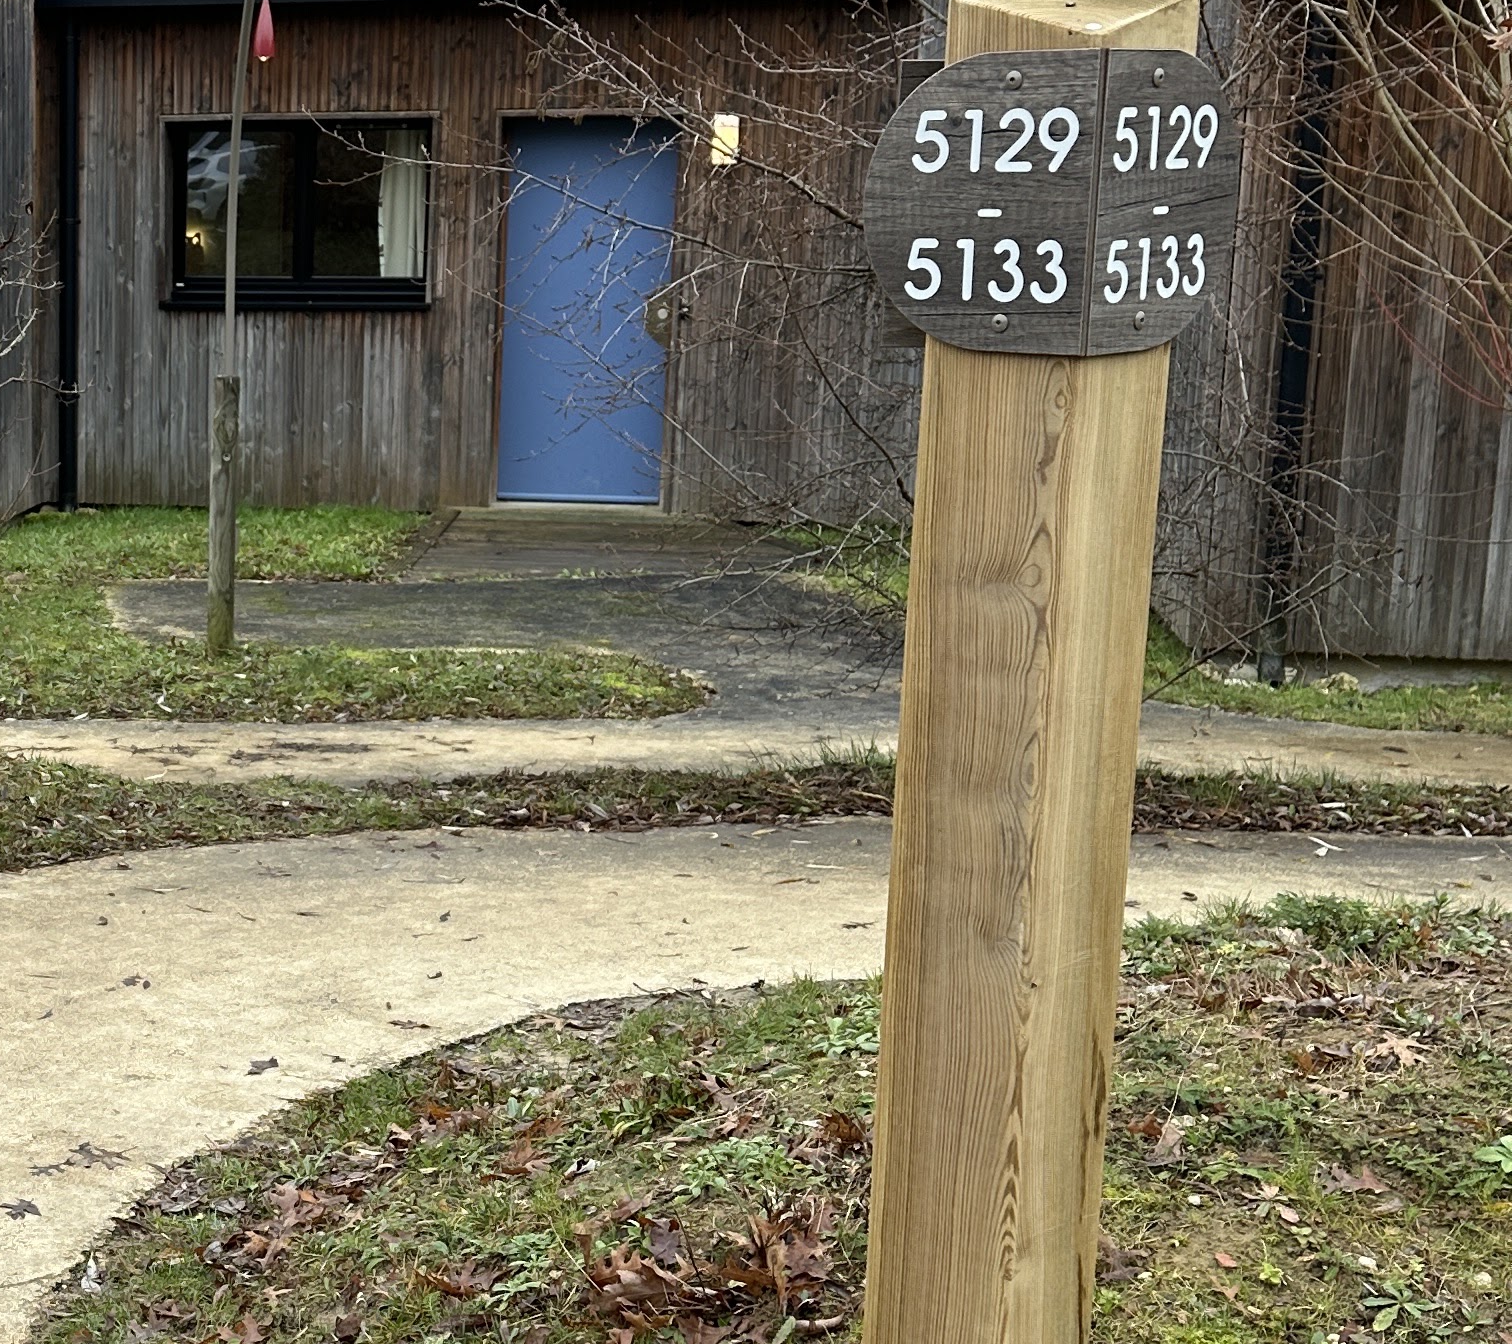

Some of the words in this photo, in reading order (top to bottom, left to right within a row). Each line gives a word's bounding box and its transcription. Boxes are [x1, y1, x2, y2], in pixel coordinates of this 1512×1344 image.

[911, 107, 1080, 173] 5129
[1112, 104, 1218, 173] 5129
[904, 238, 1068, 304] 5133
[1103, 233, 1206, 304] 5133
